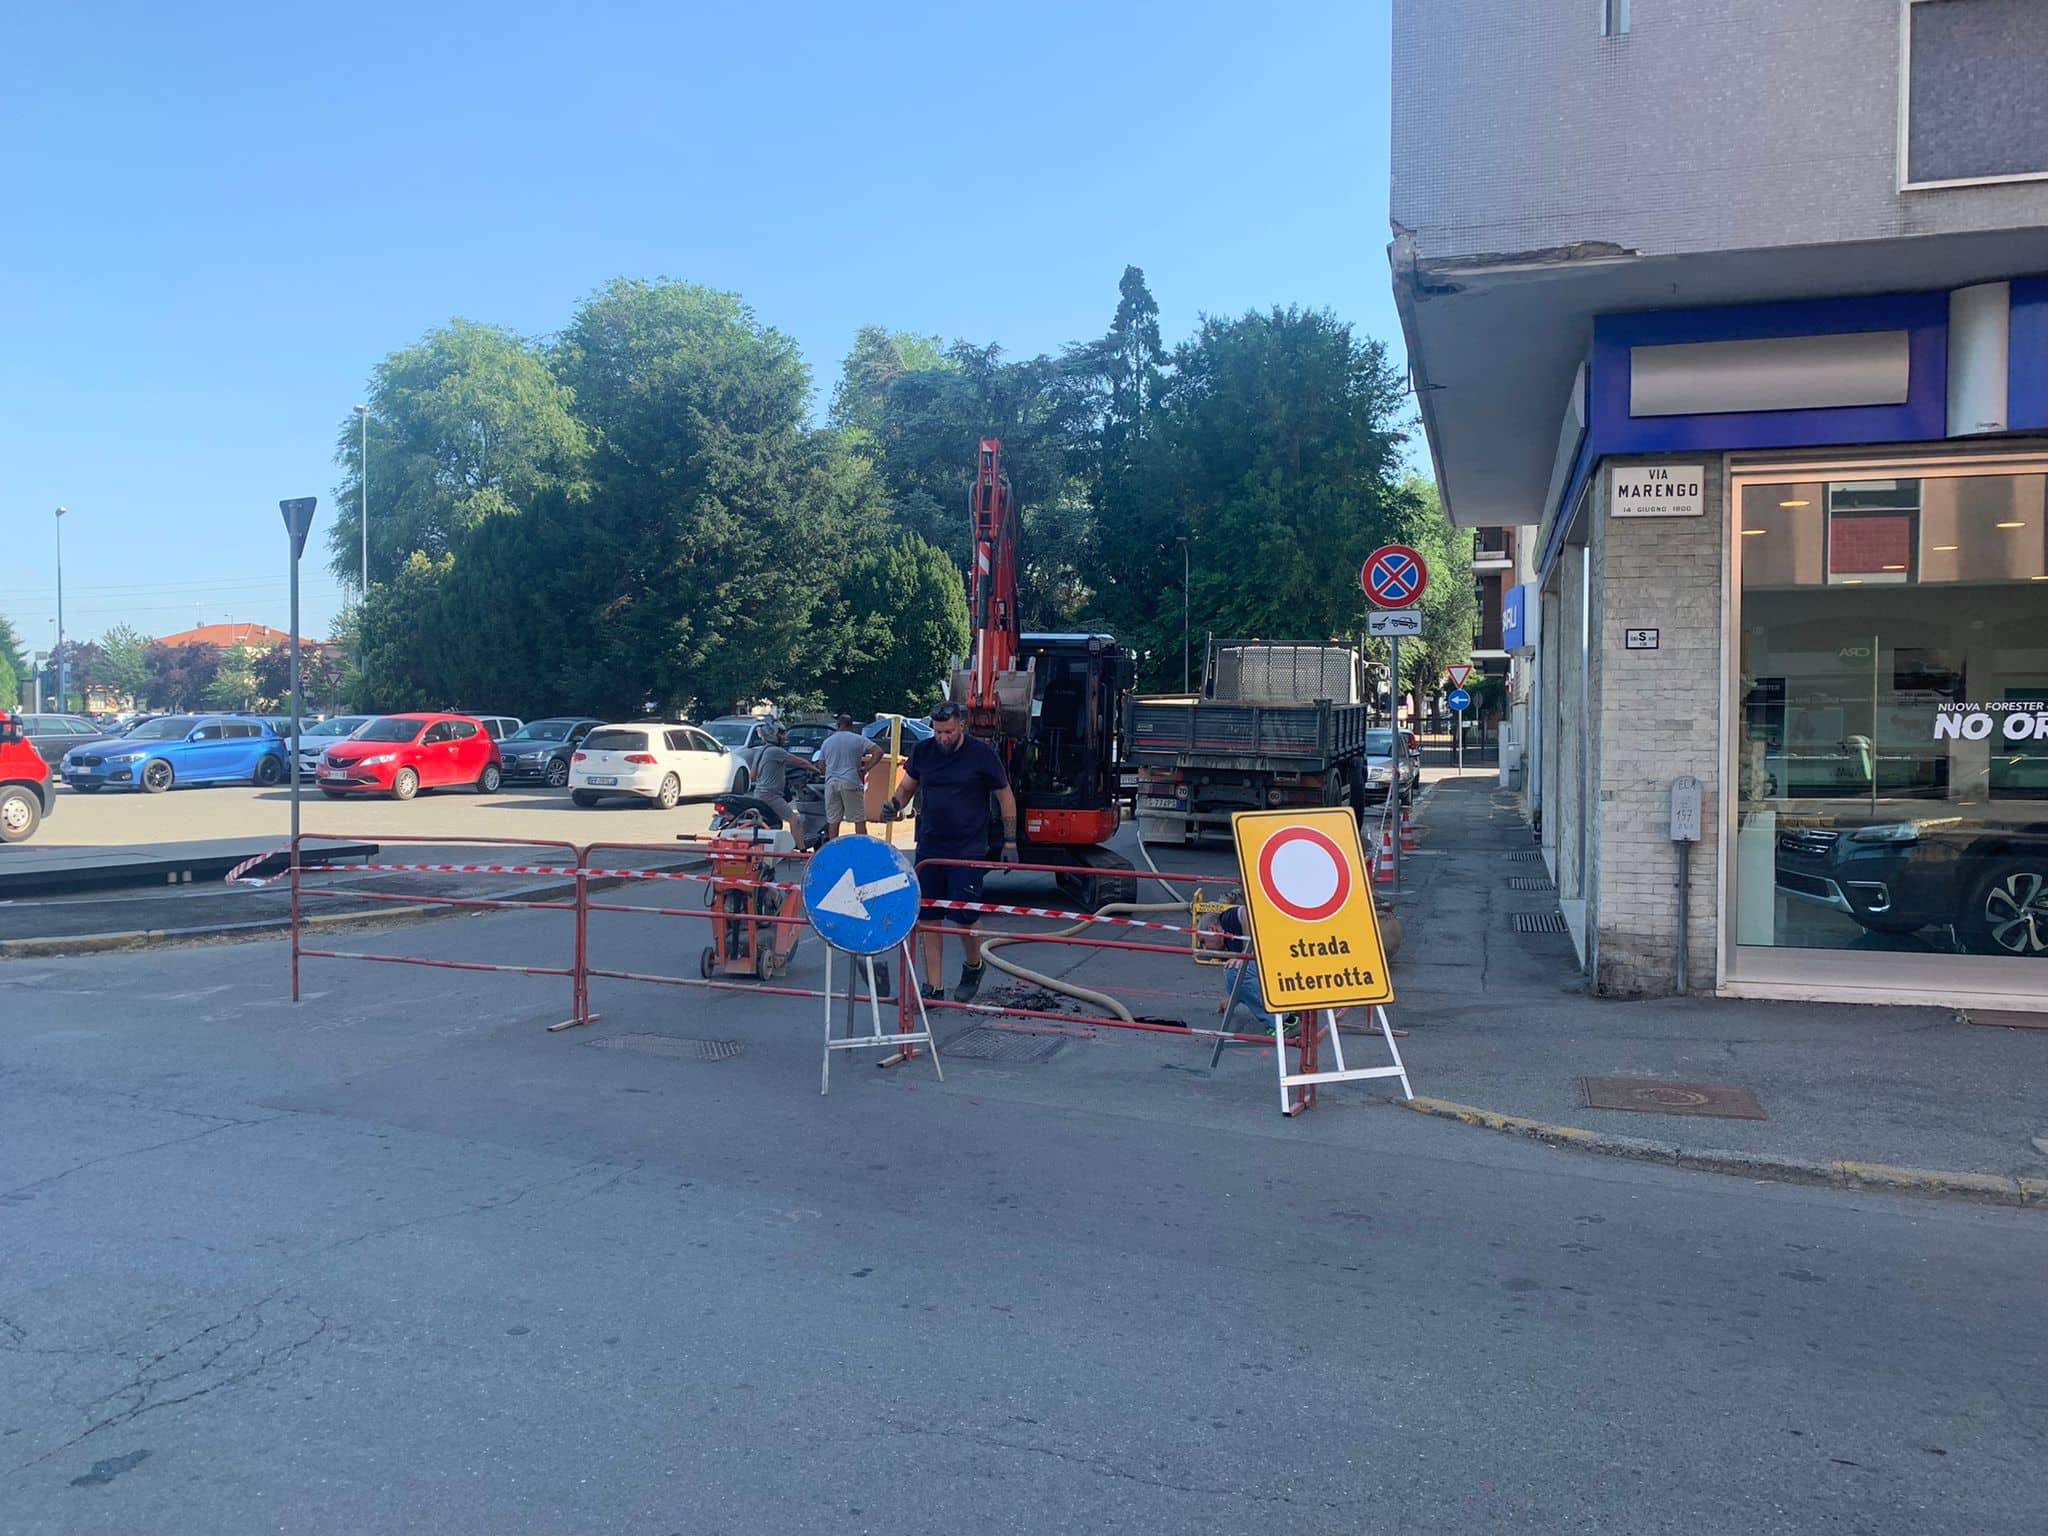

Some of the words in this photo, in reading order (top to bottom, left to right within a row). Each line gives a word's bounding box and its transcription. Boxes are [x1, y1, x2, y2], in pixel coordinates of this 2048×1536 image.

[1649, 469, 1668, 480] VIA
[1618, 483, 1698, 498] MARENGO
[1638, 632, 1646, 641] S
[1938, 703, 1980, 712] NUOVA
[1985, 702, 2044, 711] FORESTER
[1934, 713, 1993, 740] NO
[1290, 936, 1350, 958] strada
[1277, 967, 1374, 992] interrotta
